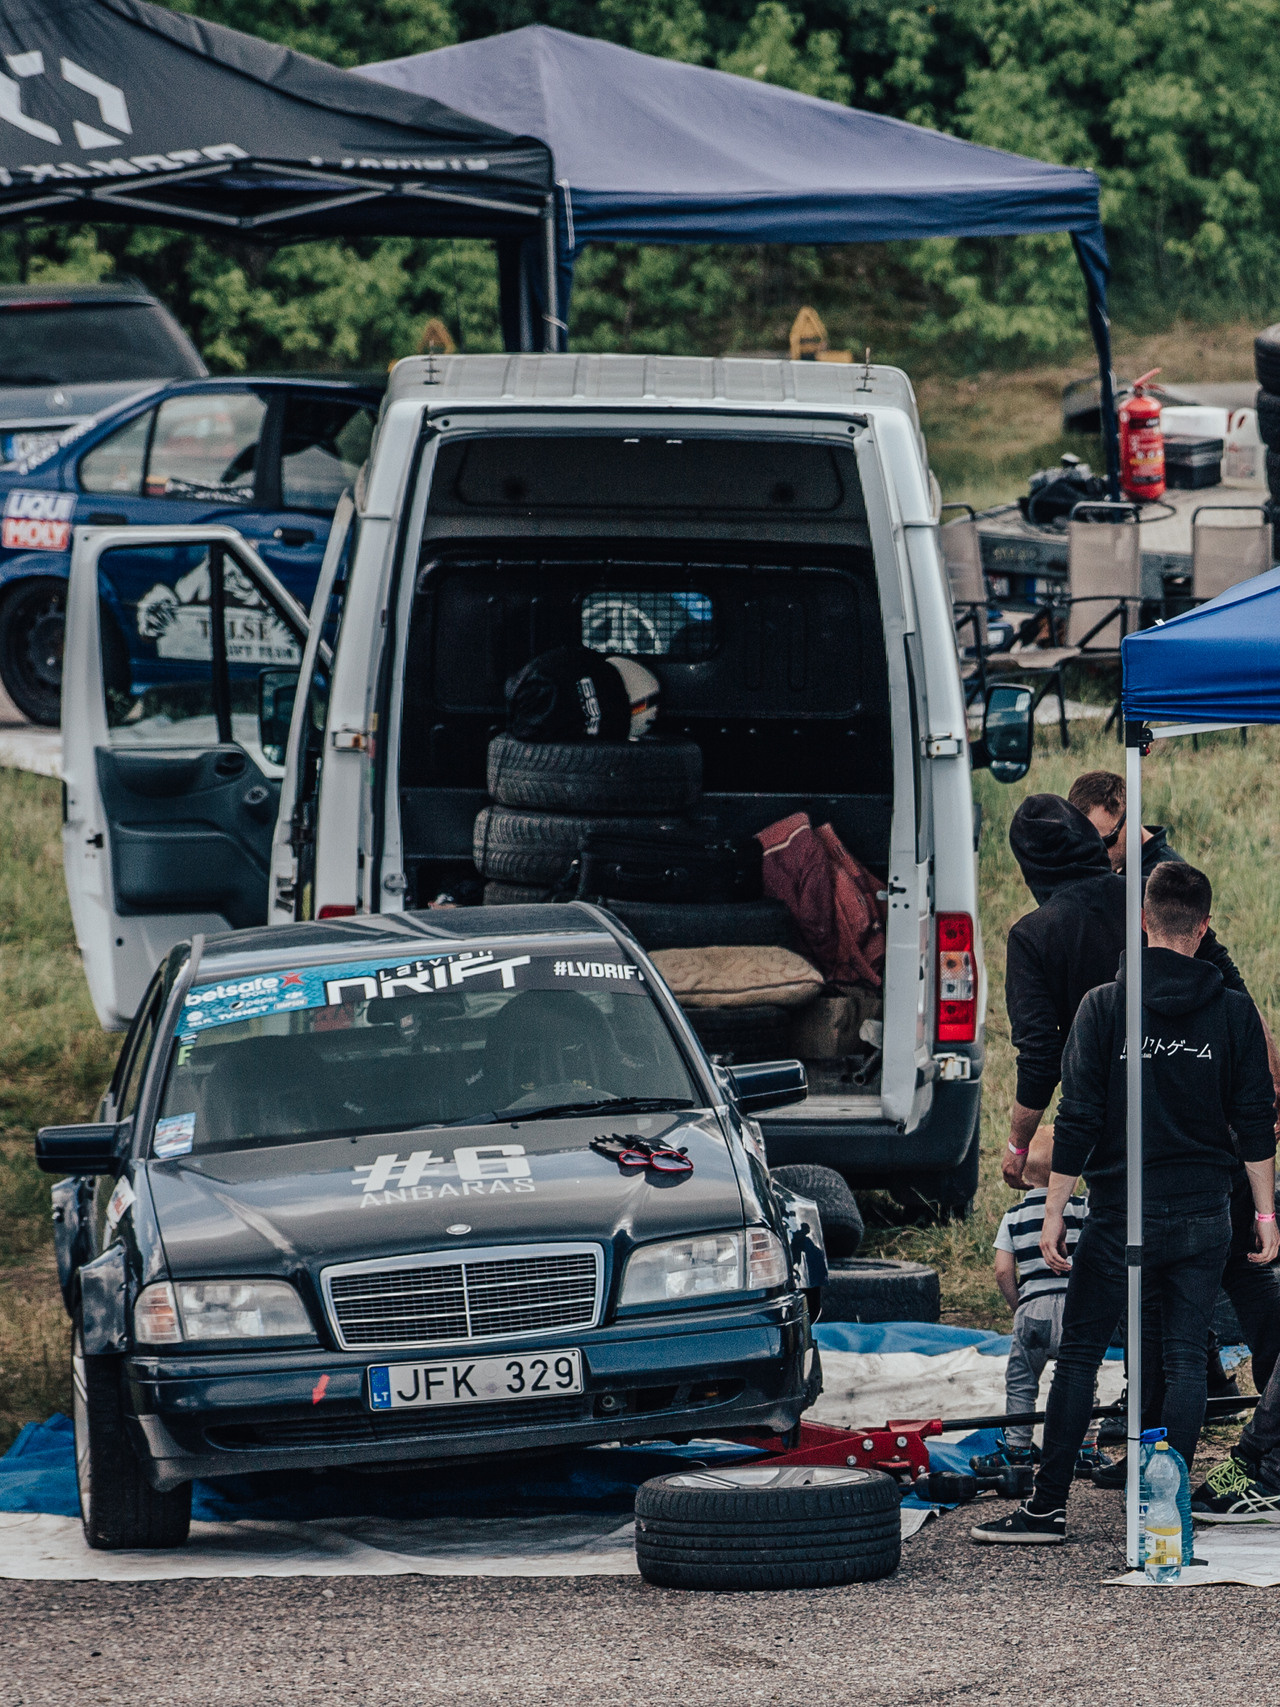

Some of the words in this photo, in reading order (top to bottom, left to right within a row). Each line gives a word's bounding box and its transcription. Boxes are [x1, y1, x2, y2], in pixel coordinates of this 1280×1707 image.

[6, 520, 69, 548] MOLY
[185, 978, 279, 1007] betsafe
[240, 987, 278, 1000] SPORTS
[326, 955, 531, 1007] DRIFT
[177, 1044, 194, 1066] F
[351, 1144, 532, 1192] #6
[360, 1178, 536, 1208] ANGARAS
[396, 1364, 478, 1402] JFK
[505, 1356, 574, 1394] 329
[373, 1391, 389, 1403] LT
